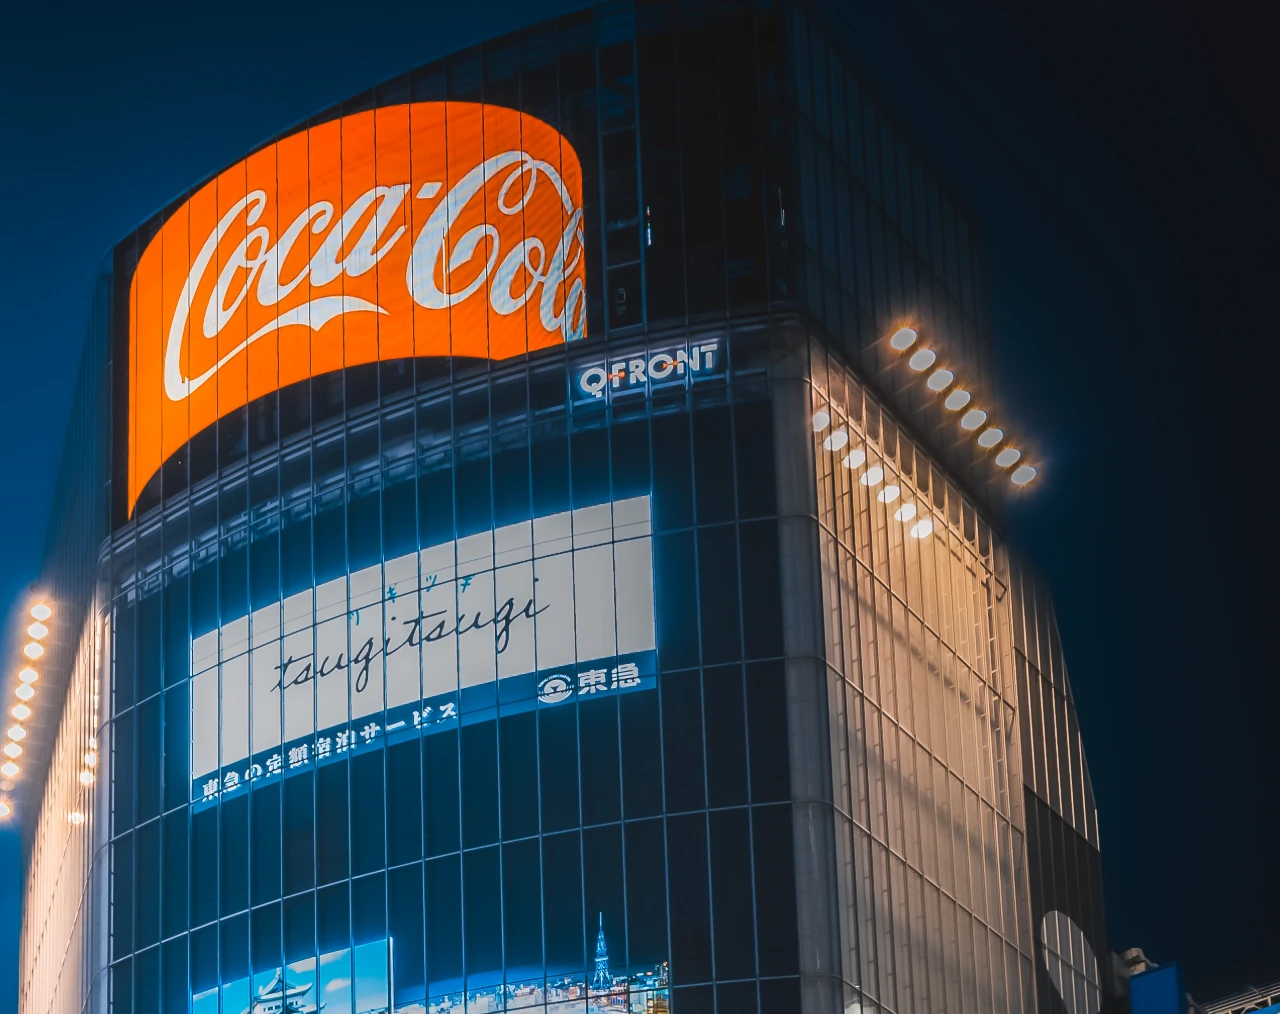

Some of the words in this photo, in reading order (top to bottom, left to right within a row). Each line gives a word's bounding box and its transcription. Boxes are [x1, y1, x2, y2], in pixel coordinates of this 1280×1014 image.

[164, 150, 587, 401] Coca-Cola
[580, 344, 718, 398] QFRONT
[270, 577, 550, 693] tsugitsugi
[577, 663, 641, 695] 東急
[202, 703, 458, 802] 東急の定額宿泊サービス
